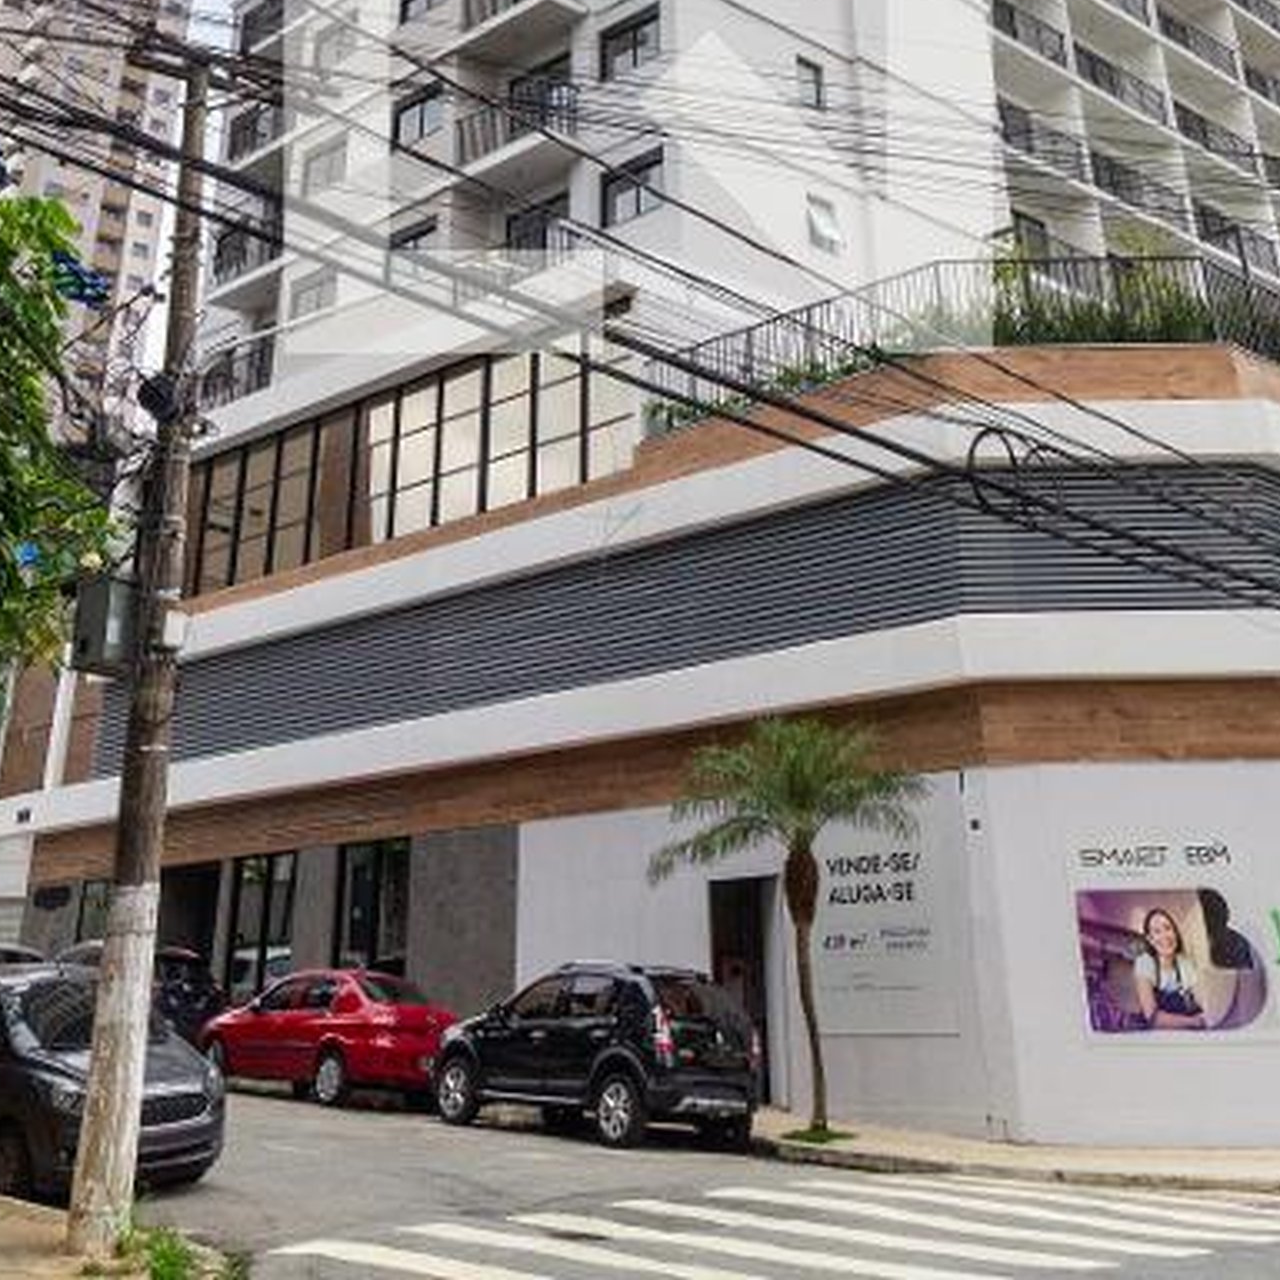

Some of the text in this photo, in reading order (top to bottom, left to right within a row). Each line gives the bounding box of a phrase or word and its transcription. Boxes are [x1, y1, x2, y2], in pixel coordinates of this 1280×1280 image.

[1078, 844, 1232, 868] SMART EBM
[828, 881, 914, 906] ALUGA-SE
